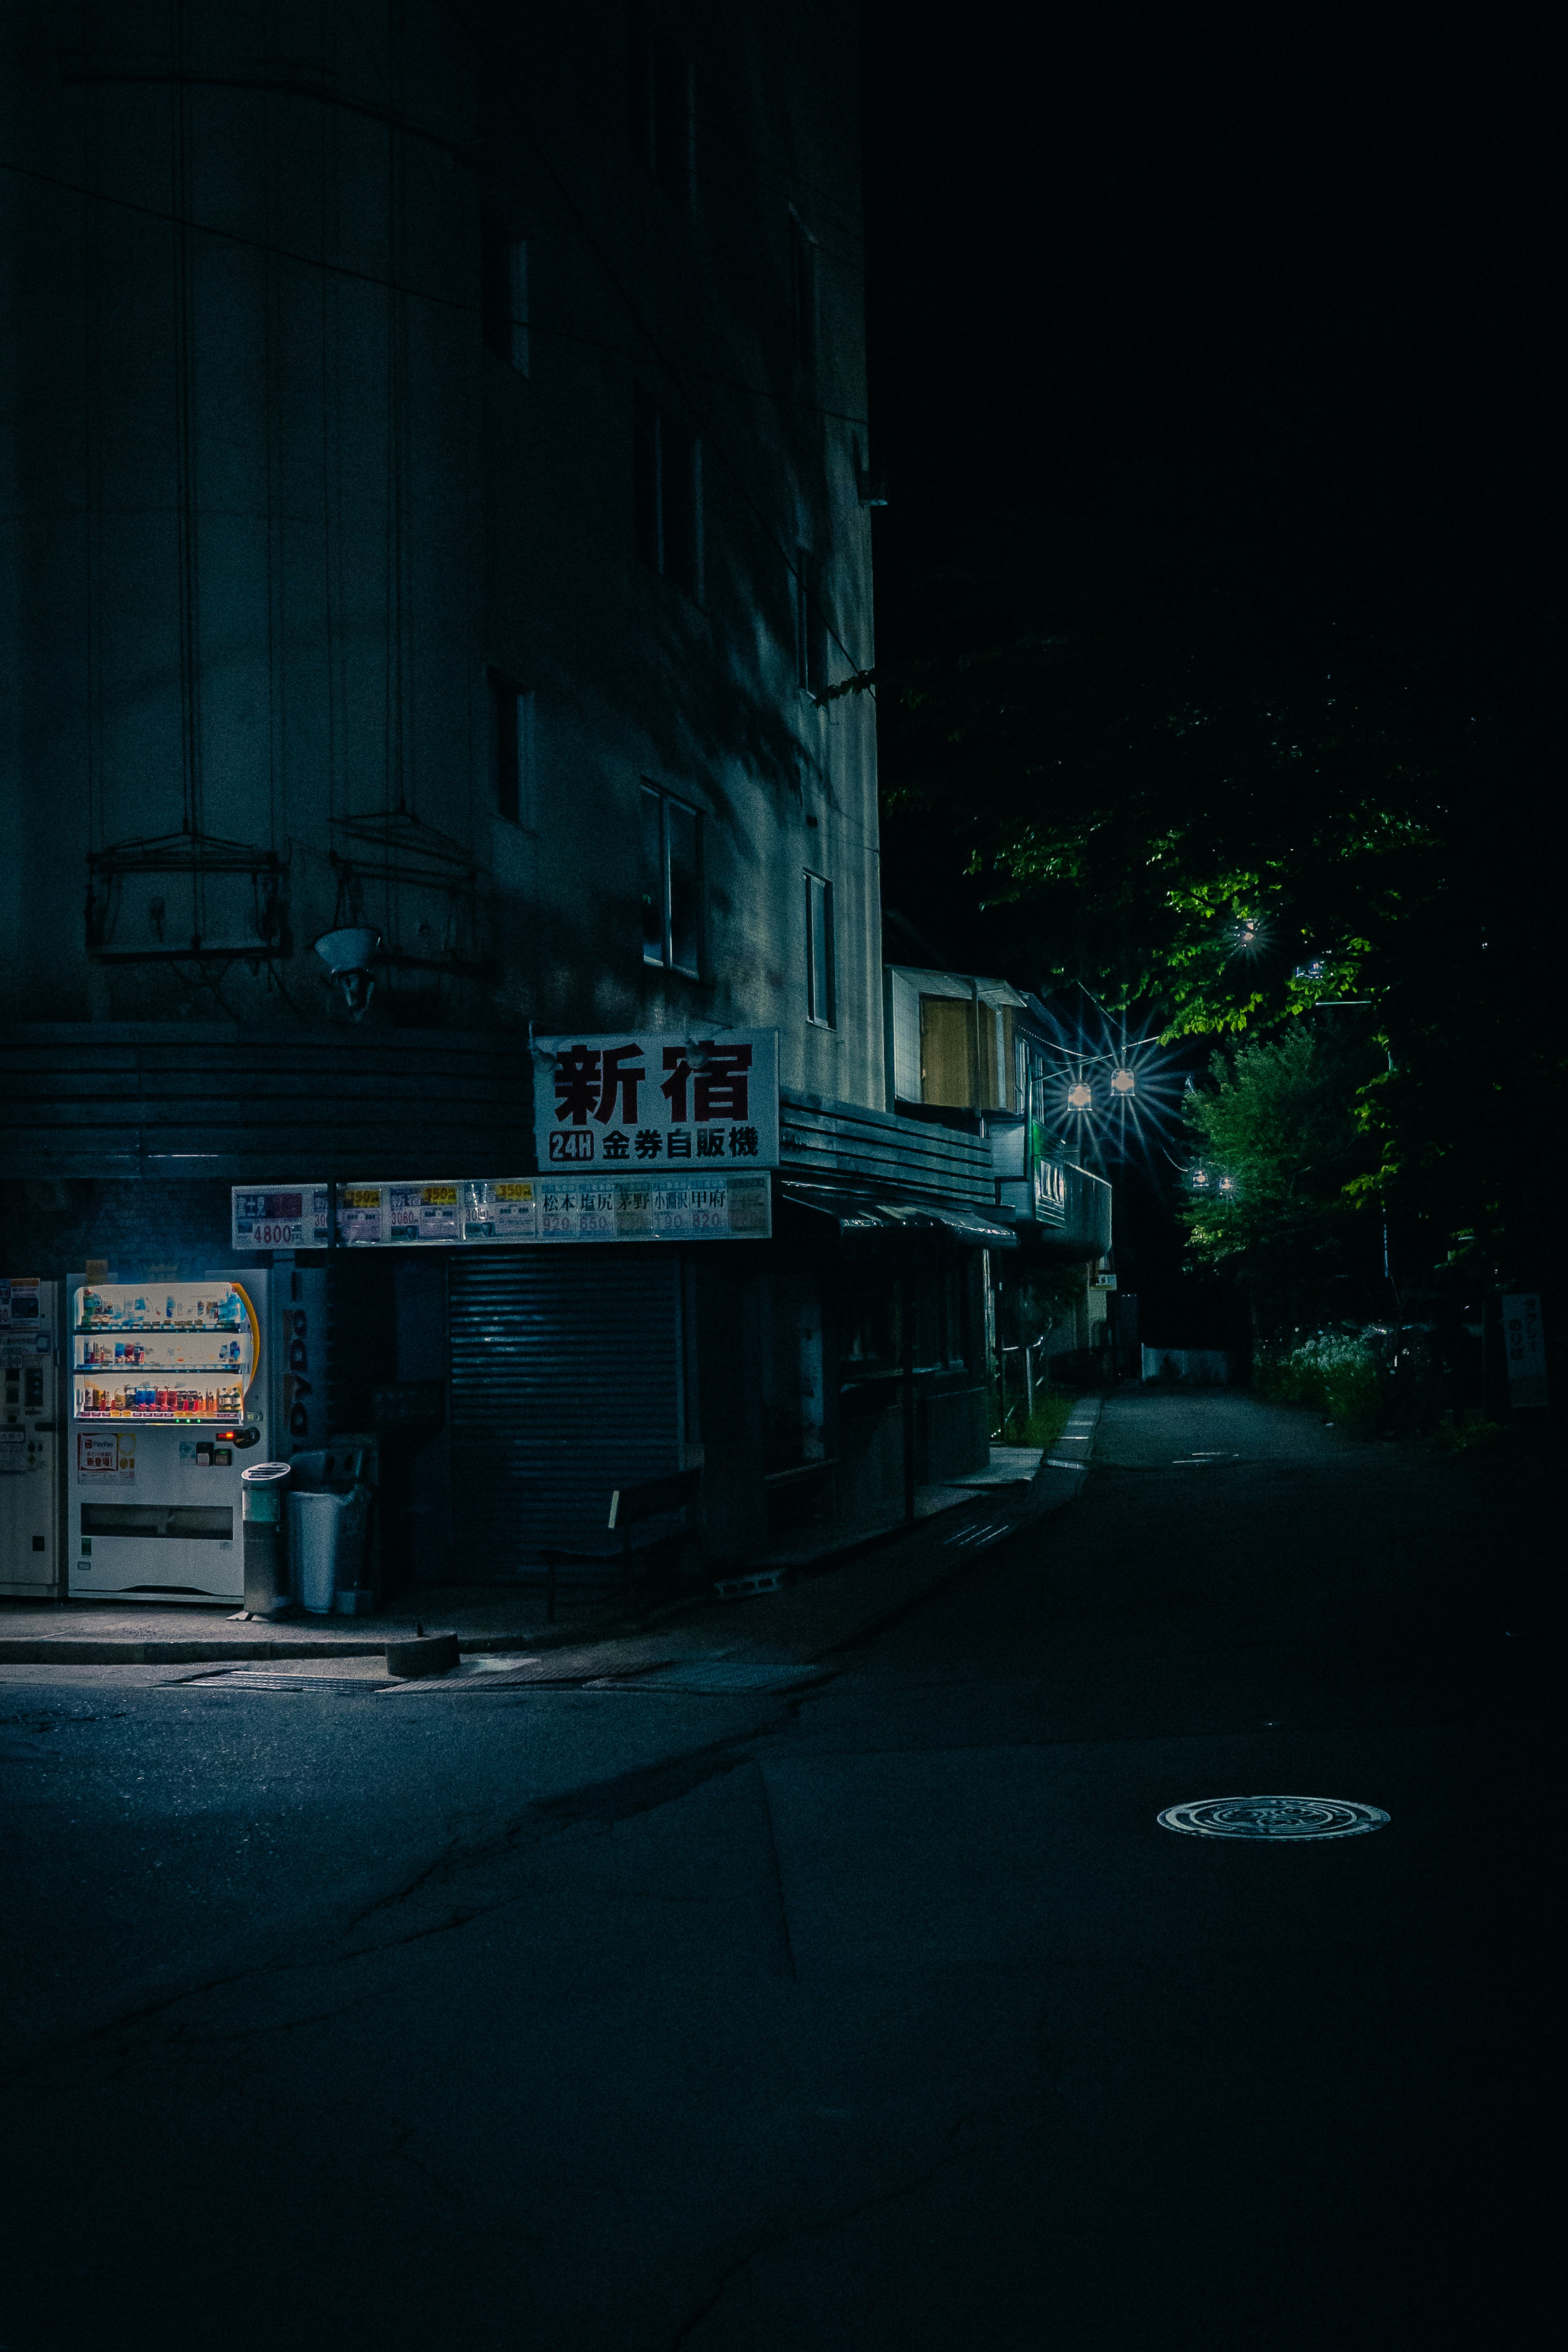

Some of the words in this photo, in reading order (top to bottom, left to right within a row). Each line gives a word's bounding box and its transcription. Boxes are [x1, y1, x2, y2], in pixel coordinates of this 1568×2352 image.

[555, 1040, 752, 1125] 新宿
[552, 1133, 592, 1158] 24H
[603, 1127, 758, 1160] 金券自販機
[237, 1197, 265, 1217] 富士見
[392, 1194, 422, 1206] 新宿
[543, 1194, 575, 1212] 松本
[581, 1193, 612, 1211] 塩尻
[618, 1192, 650, 1210] 茅野
[691, 1189, 725, 1208] 甲府
[392, 1212, 414, 1225] 3060
[543, 1217, 569, 1230] 920
[580, 1217, 607, 1230] 650
[693, 1213, 720, 1227] 820
[1525, 1298, 1537, 1352] タクシー
[1509, 1319, 1524, 1360] のりば
